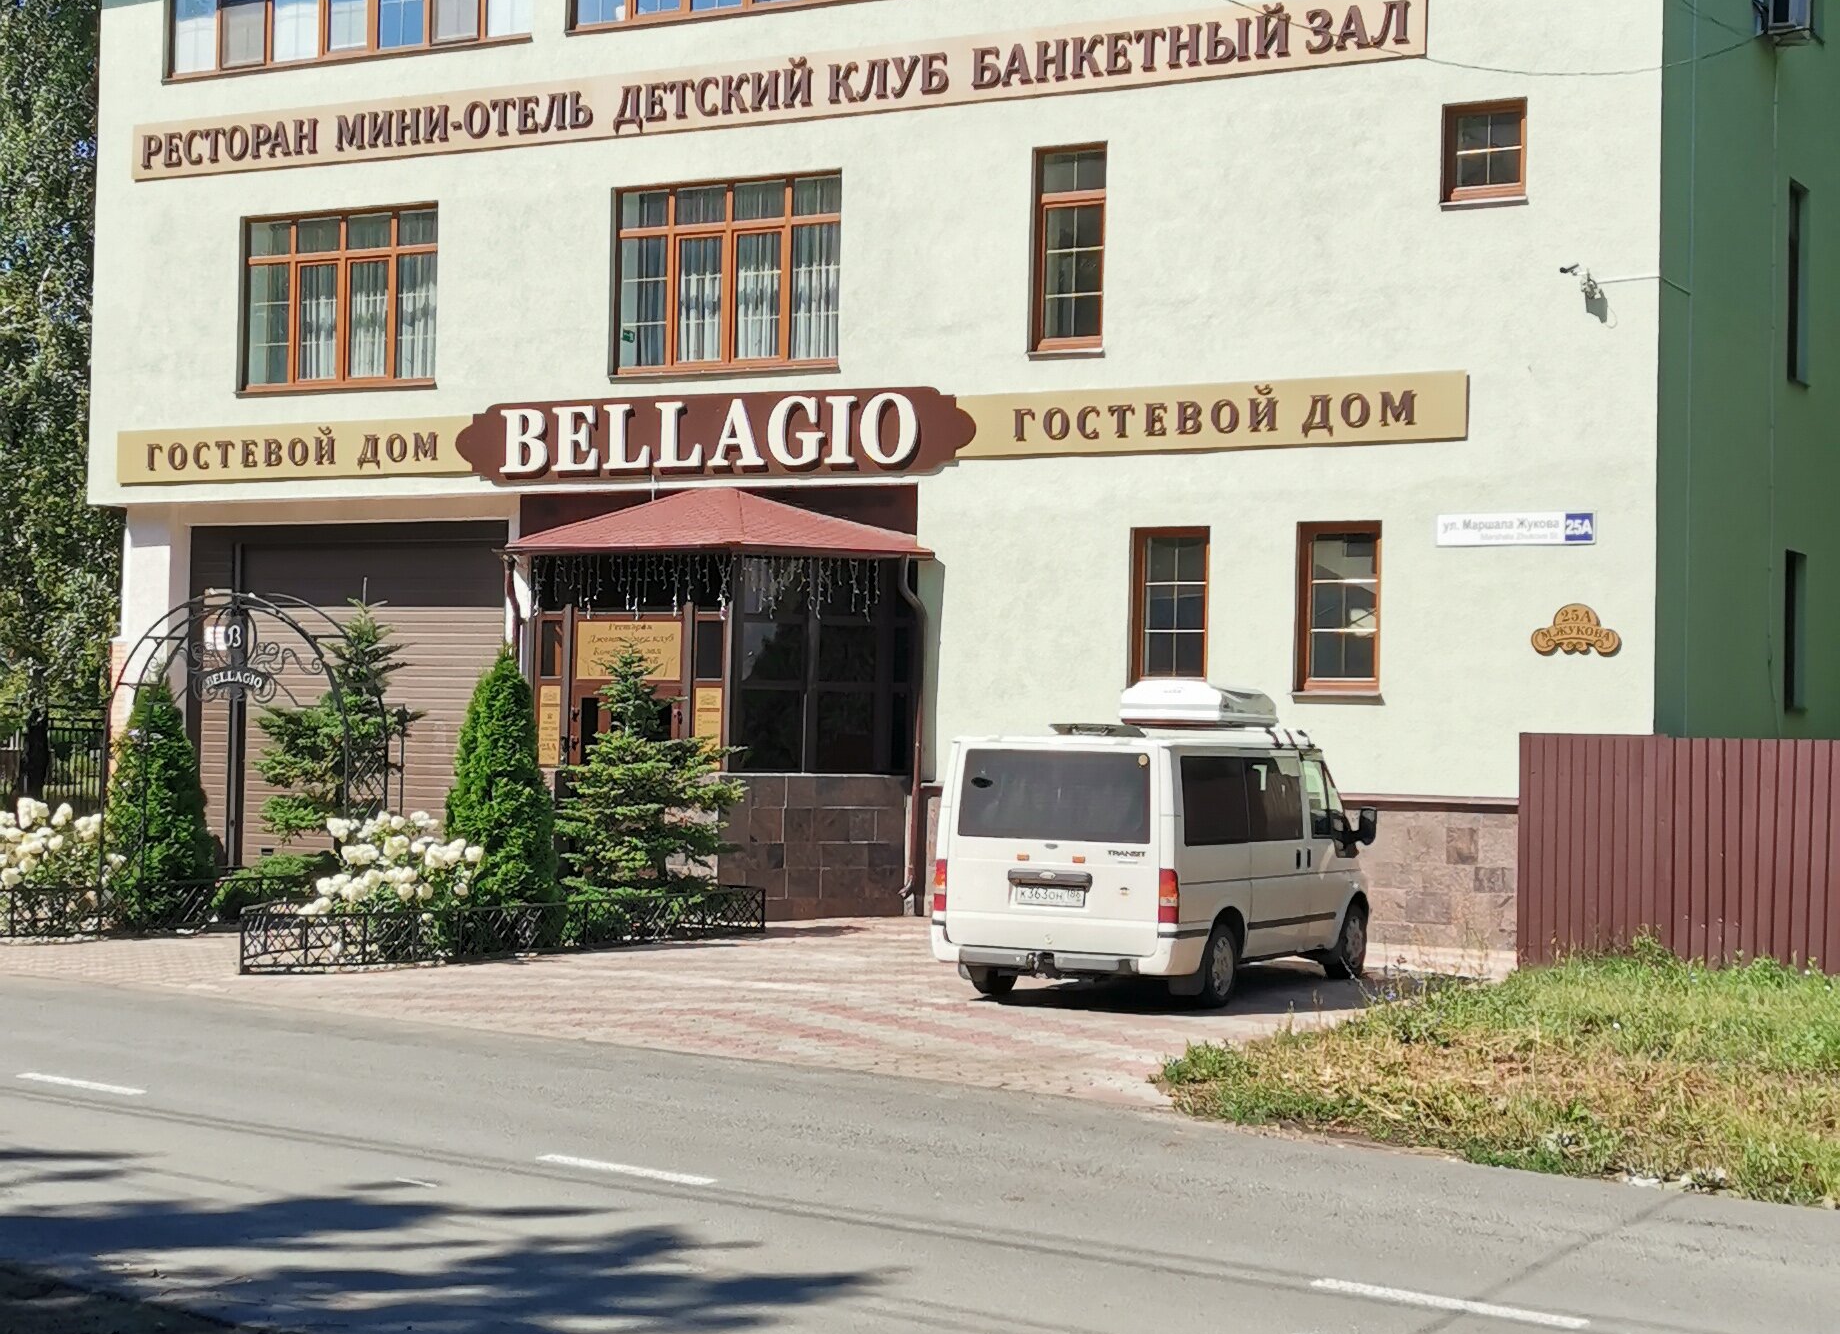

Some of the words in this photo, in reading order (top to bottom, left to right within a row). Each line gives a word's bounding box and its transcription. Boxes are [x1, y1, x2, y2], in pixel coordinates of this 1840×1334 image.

[141, 117, 318, 169] РЕСТОРАН
[336, 89, 594, 151] МИНИ-ОТЕЛЬ
[612, 55, 813, 134] ДЕТСКИЙ
[827, 51, 949, 104] КЛУБ
[971, 2, 1291, 90] БАНКЕТНЫЙ
[1012, 383, 1280, 443] ГОСТЕВОЙ
[1301, 388, 1419, 438] ДОМ
[499, 392, 919, 476] BELLAGIO
[146, 425, 337, 471] ГОСТЕВОЙ
[357, 431, 439, 468] ДОМ
[1462, 519, 1514, 532] Маршала
[1516, 517, 1560, 531] Жукова
[1565, 518, 1593, 536] 25А
[1561, 609, 1592, 623] 25А
[204, 670, 262, 688] BELLAGIO
[1107, 849, 1146, 857] TRANSIT
